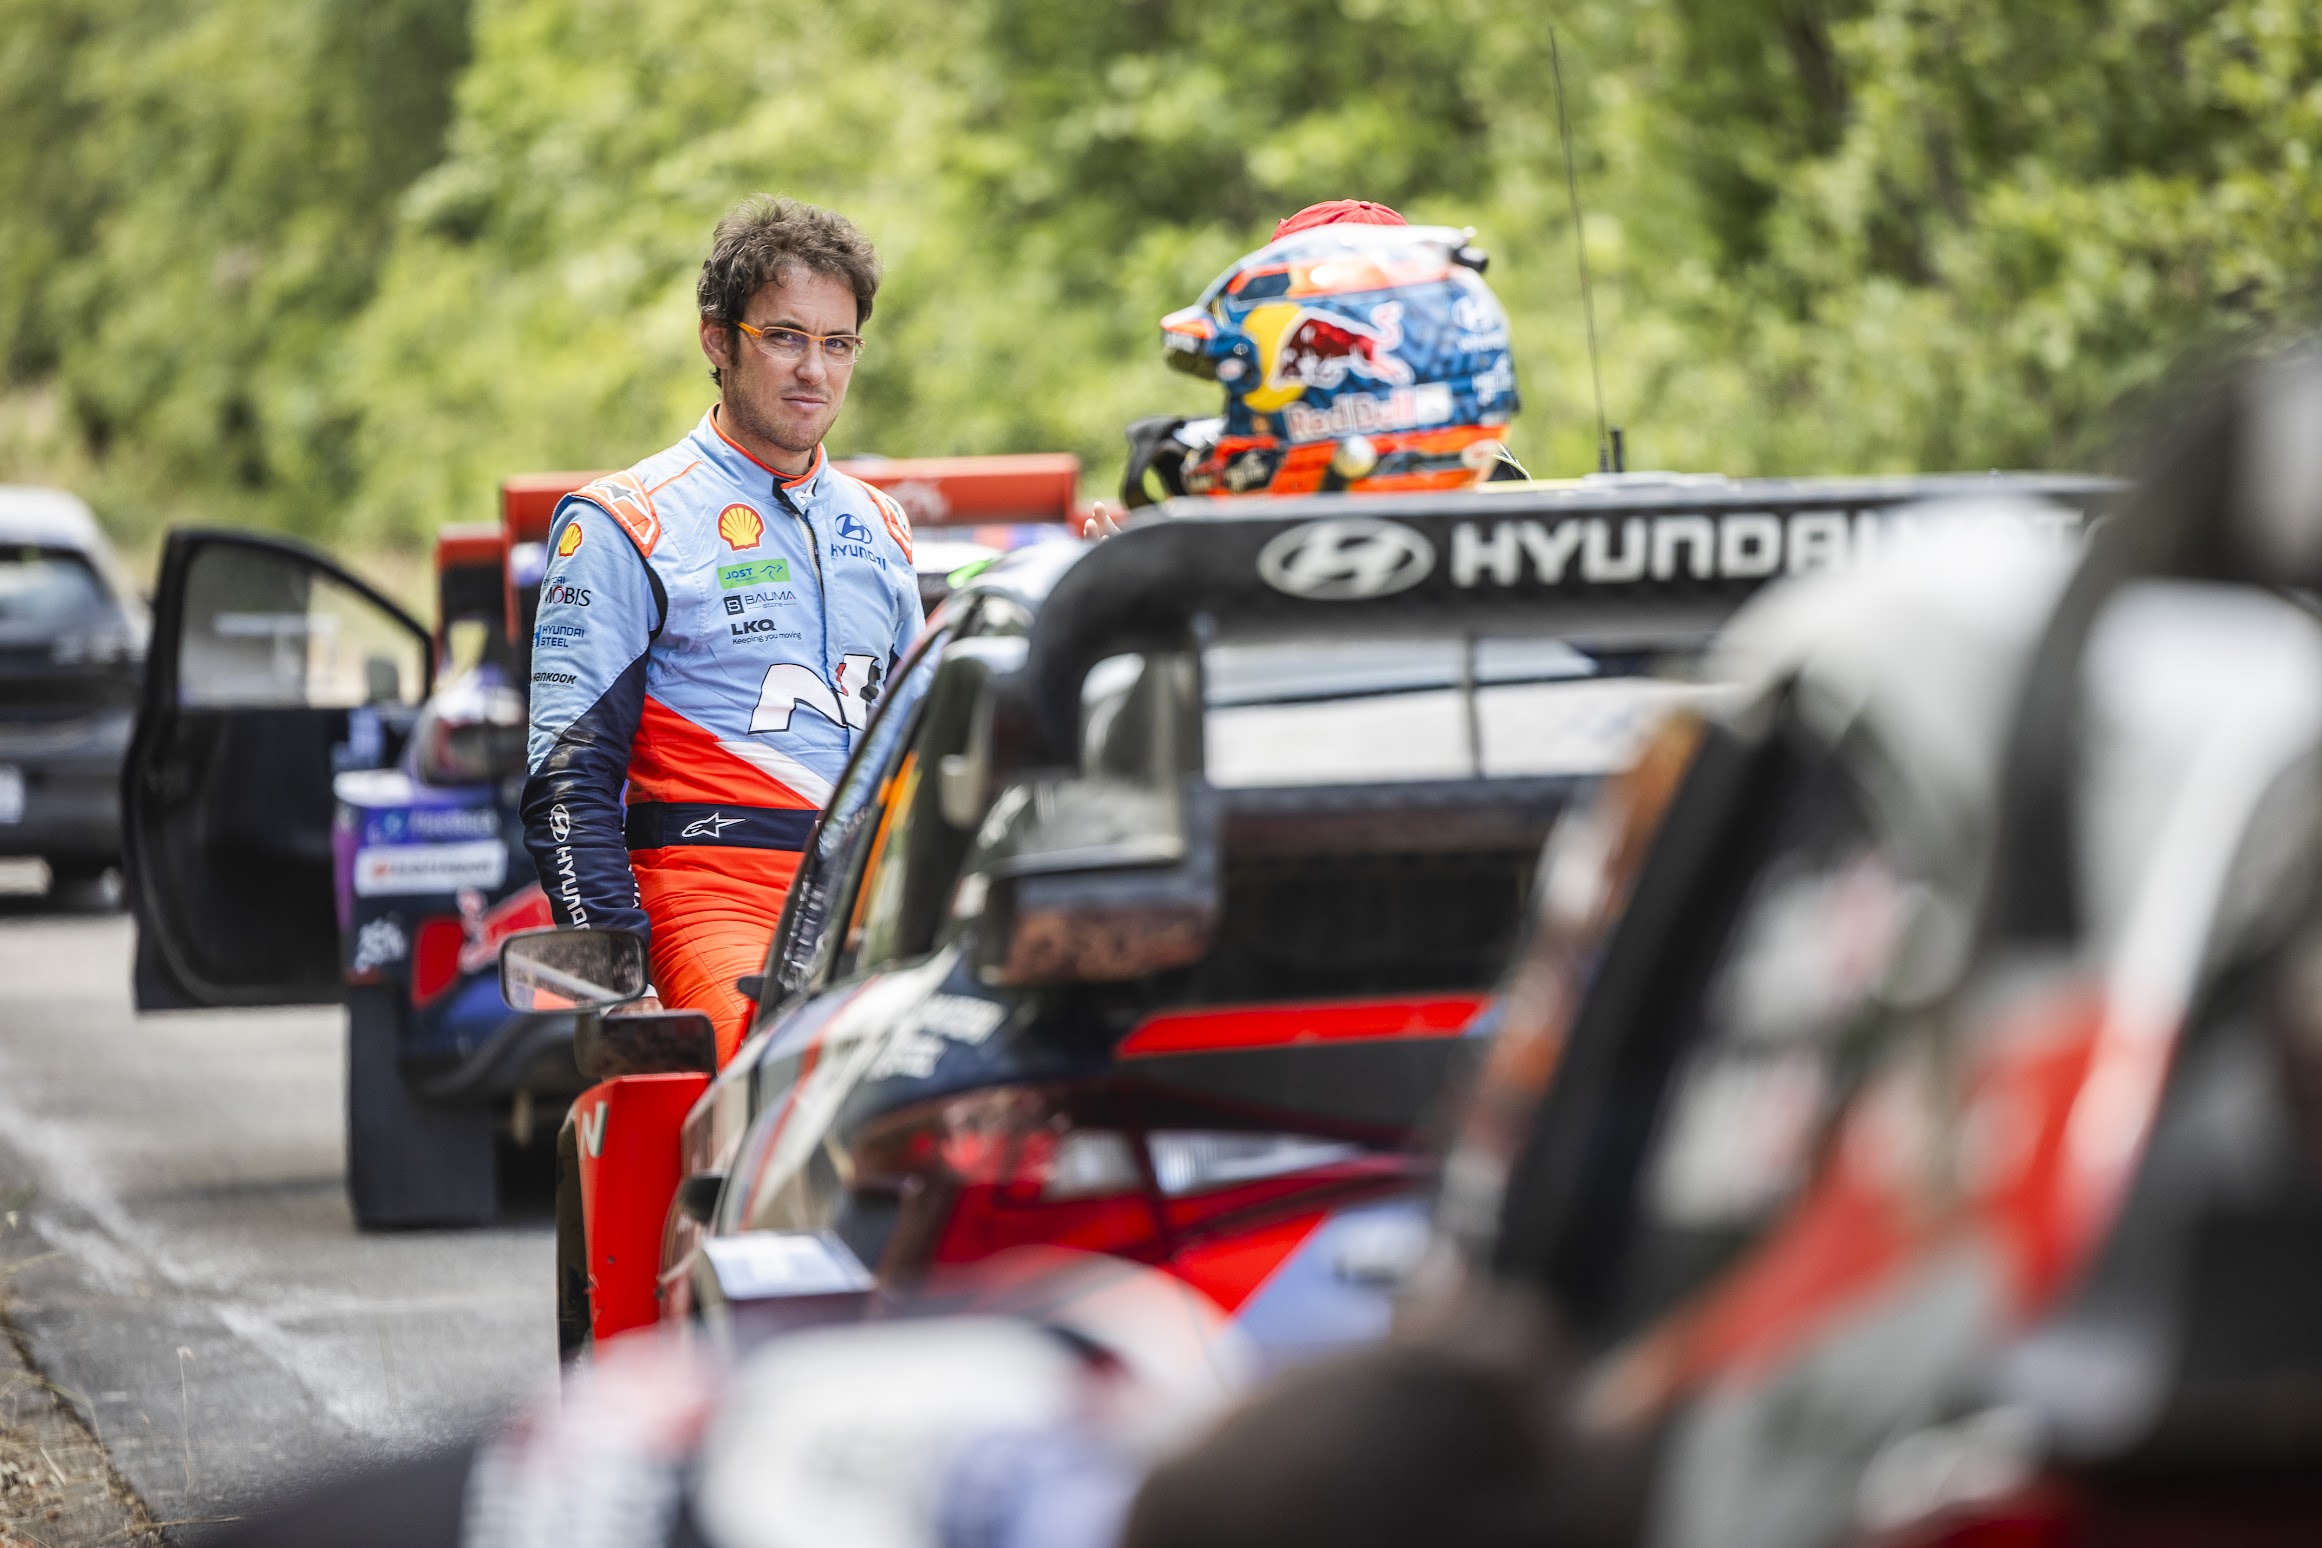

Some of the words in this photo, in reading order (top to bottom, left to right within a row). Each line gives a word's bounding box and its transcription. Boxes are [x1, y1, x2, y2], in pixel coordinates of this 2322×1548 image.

[831, 543, 887, 571] HYUNDAI
[1449, 509, 1880, 589] HYUNDAI
[725, 567, 753, 580] JOST
[544, 585, 592, 607] MOBIS
[542, 625, 585, 639] HYUNDAI
[731, 619, 777, 636] LKQ
[540, 636, 569, 648] STEEL
[732, 635, 765, 645] Keeping
[765, 633, 778, 642] you
[778, 631, 802, 641] moving
[555, 845, 591, 931] HYUND
